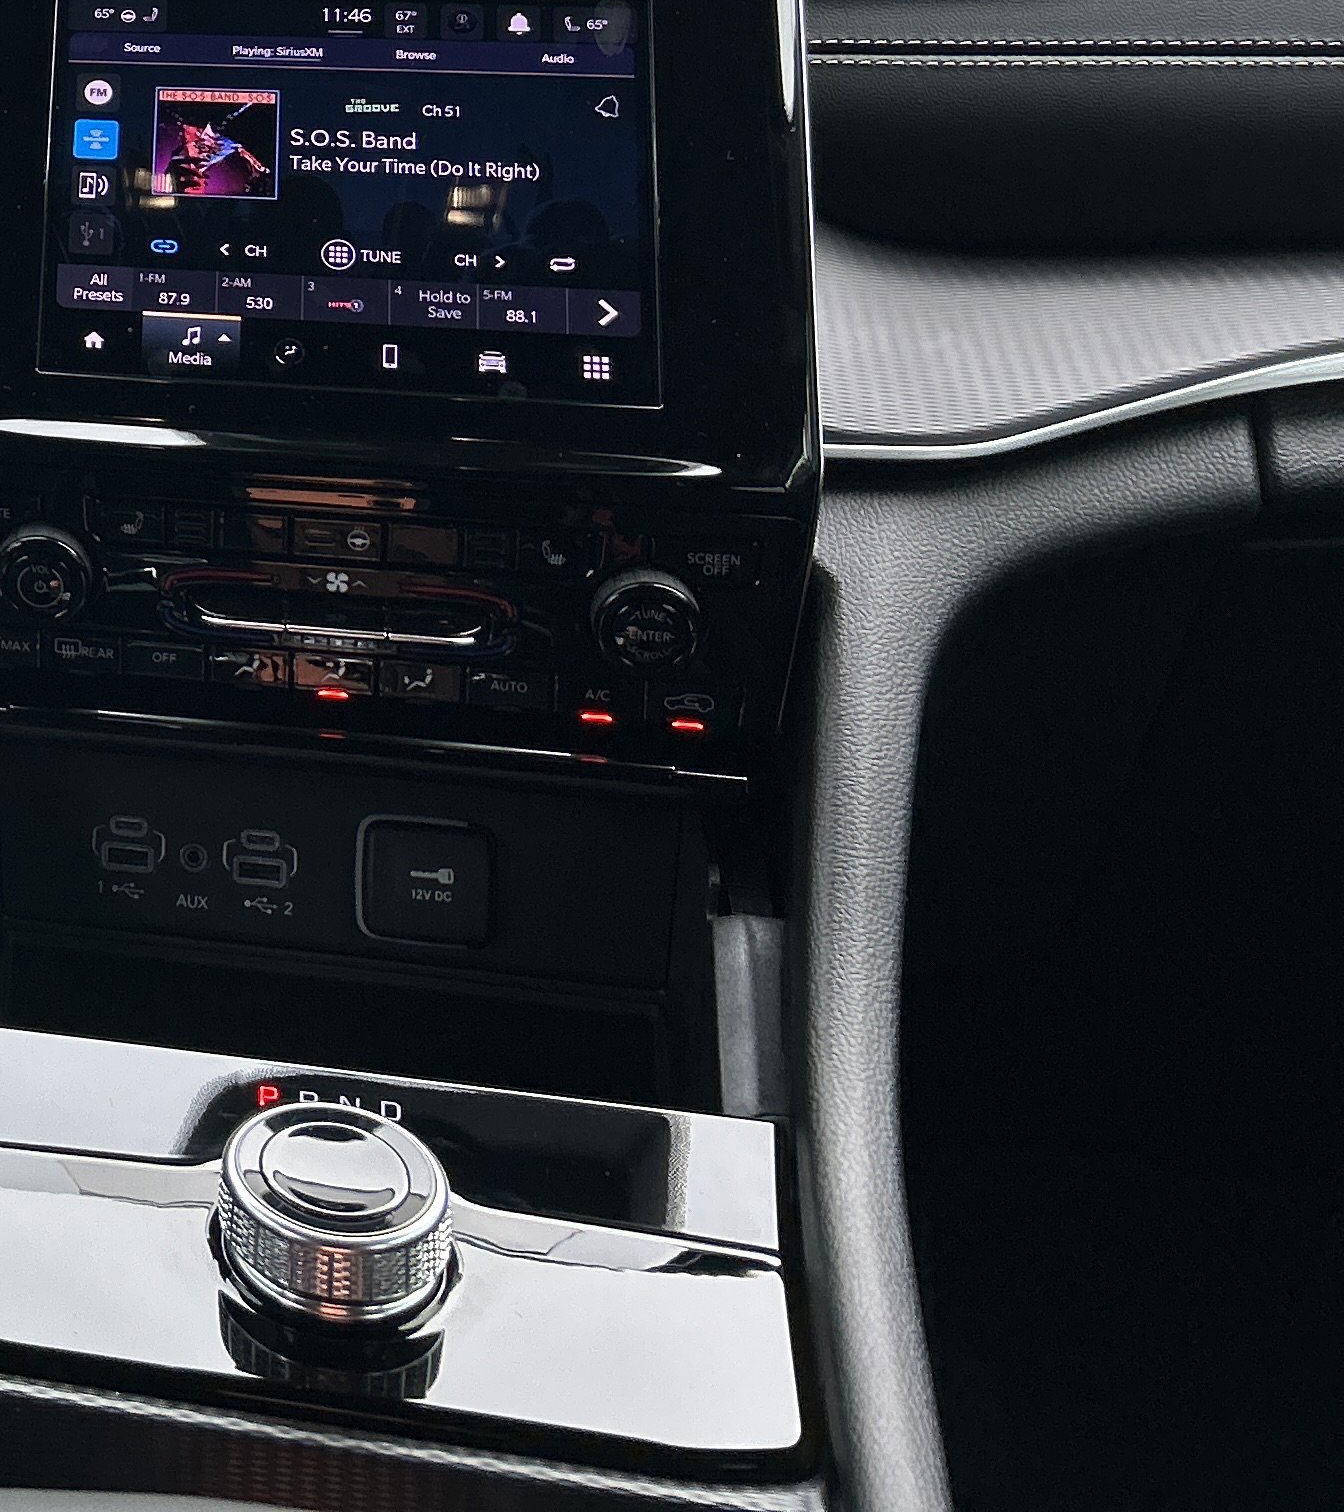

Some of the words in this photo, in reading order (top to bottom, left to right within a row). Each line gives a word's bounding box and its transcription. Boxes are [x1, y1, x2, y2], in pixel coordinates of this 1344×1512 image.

[94, 8, 115, 19] 65°
[321, 7, 372, 23] 11:46
[395, 10, 417, 21] 67°
[396, 24, 415, 34] EXT
[586, 19, 608, 30] 65°
[123, 42, 161, 54] Source
[232, 45, 274, 58] Playing:
[276, 46, 324, 58] SiriusXM
[396, 49, 437, 62] Browse
[541, 53, 575, 65] Audio
[89, 88, 108, 98] FM
[210, 93, 240, 102] BAND
[345, 104, 400, 113] GROOVE
[422, 105, 442, 118] Ch
[444, 105, 461, 118] 51
[289, 129, 356, 148] S.O.S.
[361, 131, 417, 150] Band
[289, 155, 332, 172] Take
[335, 157, 379, 173] Your
[381, 159, 426, 175] Time
[430, 159, 463, 178] (Do
[468, 160, 481, 177] It
[486, 162, 541, 182] Right)
[244, 244, 267, 258] CH
[361, 249, 402, 264] TUNE
[454, 254, 477, 267] CH
[90, 273, 108, 286] All
[139, 273, 166, 284] 1-FM
[221, 276, 252, 288] 2-AM
[307, 281, 315, 292] 3
[395, 285, 402, 295] 4
[73, 287, 124, 304] Presets
[158, 292, 190, 306] 87.9
[419, 290, 453, 304] Hold
[456, 291, 471, 304] to
[483, 290, 512, 301] 5-FM
[246, 296, 274, 311] 530
[427, 306, 462, 320] Save
[506, 309, 538, 324] 88.1
[168, 351, 213, 367] Media
[687, 553, 741, 567] SCREEN
[703, 564, 731, 577] OFF
[634, 609, 667, 623] TUNE
[628, 629, 673, 643] ENTER
[0, 639, 31, 653] MAX
[81, 645, 115, 659] REAR
[151, 651, 177, 664] OFF
[490, 679, 529, 694] AUTO
[585, 688, 611, 702] A/C
[175, 893, 210, 910] AUX
[412, 888, 433, 902] 12V
[434, 889, 453, 903] DC
[283, 902, 294, 916] 2
[257, 1084, 280, 1107] P
[380, 1100, 402, 1122] D
